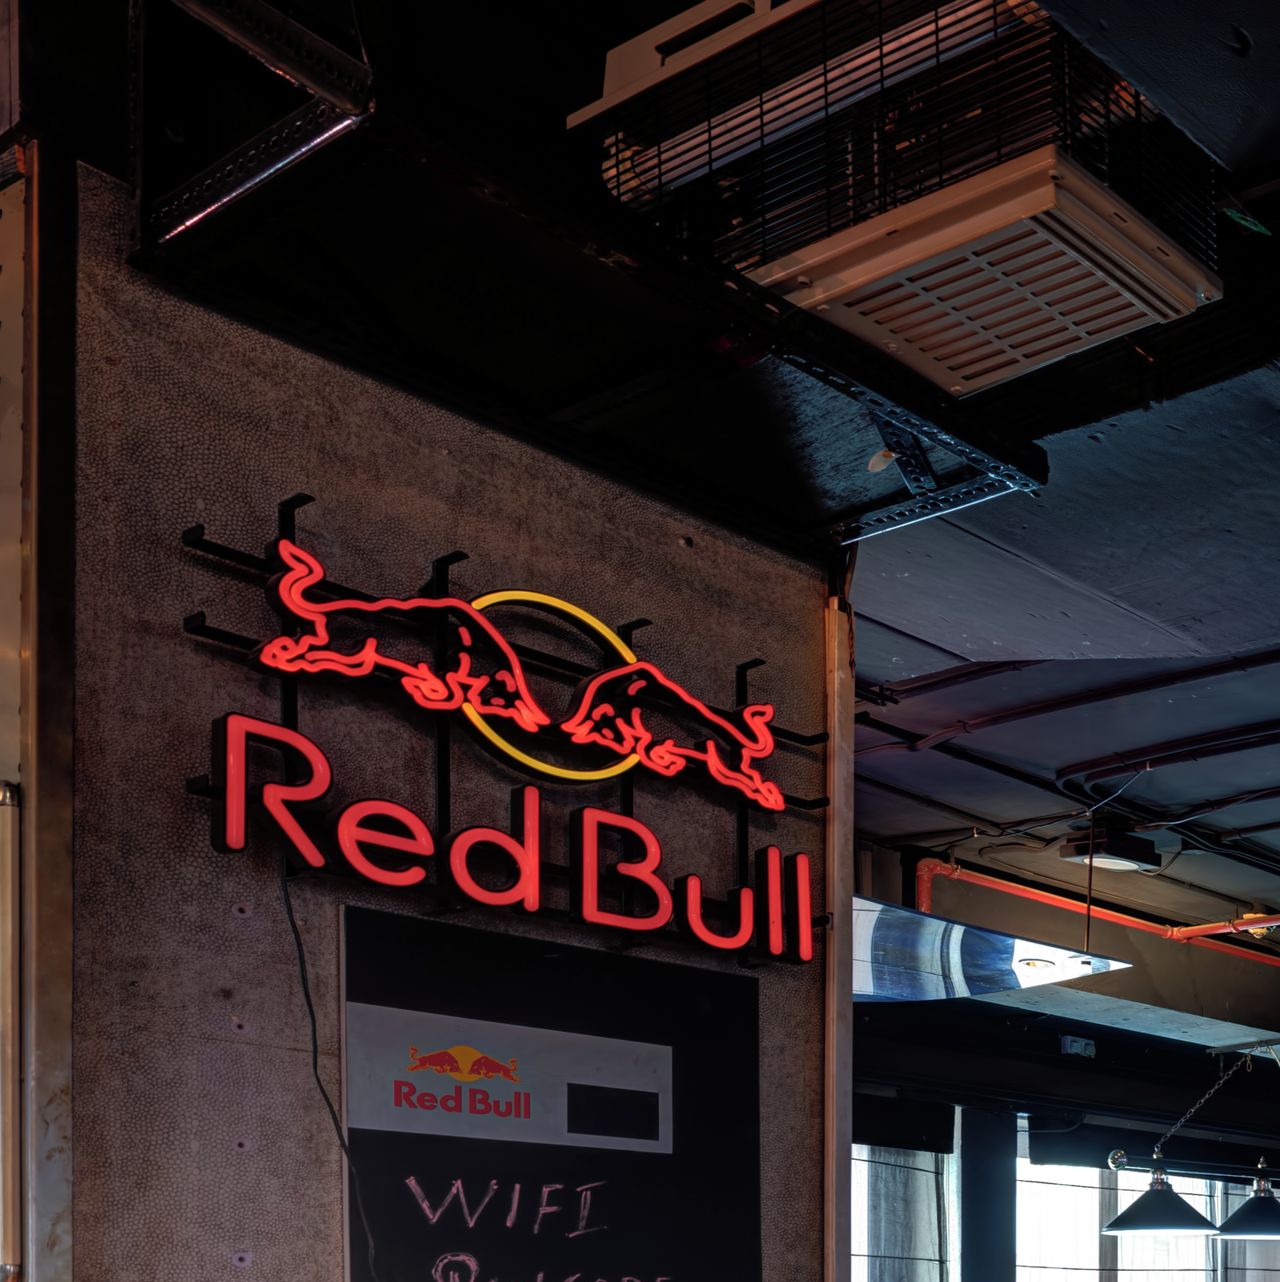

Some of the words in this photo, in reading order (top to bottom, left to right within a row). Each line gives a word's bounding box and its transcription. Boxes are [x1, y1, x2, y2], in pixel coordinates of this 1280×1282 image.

[225, 713, 541, 912] Red
[582, 807, 814, 962] Bull
[394, 1080, 462, 1113] Red
[469, 1087, 531, 1119] Bull
[405, 1177, 609, 1238] WIFI
